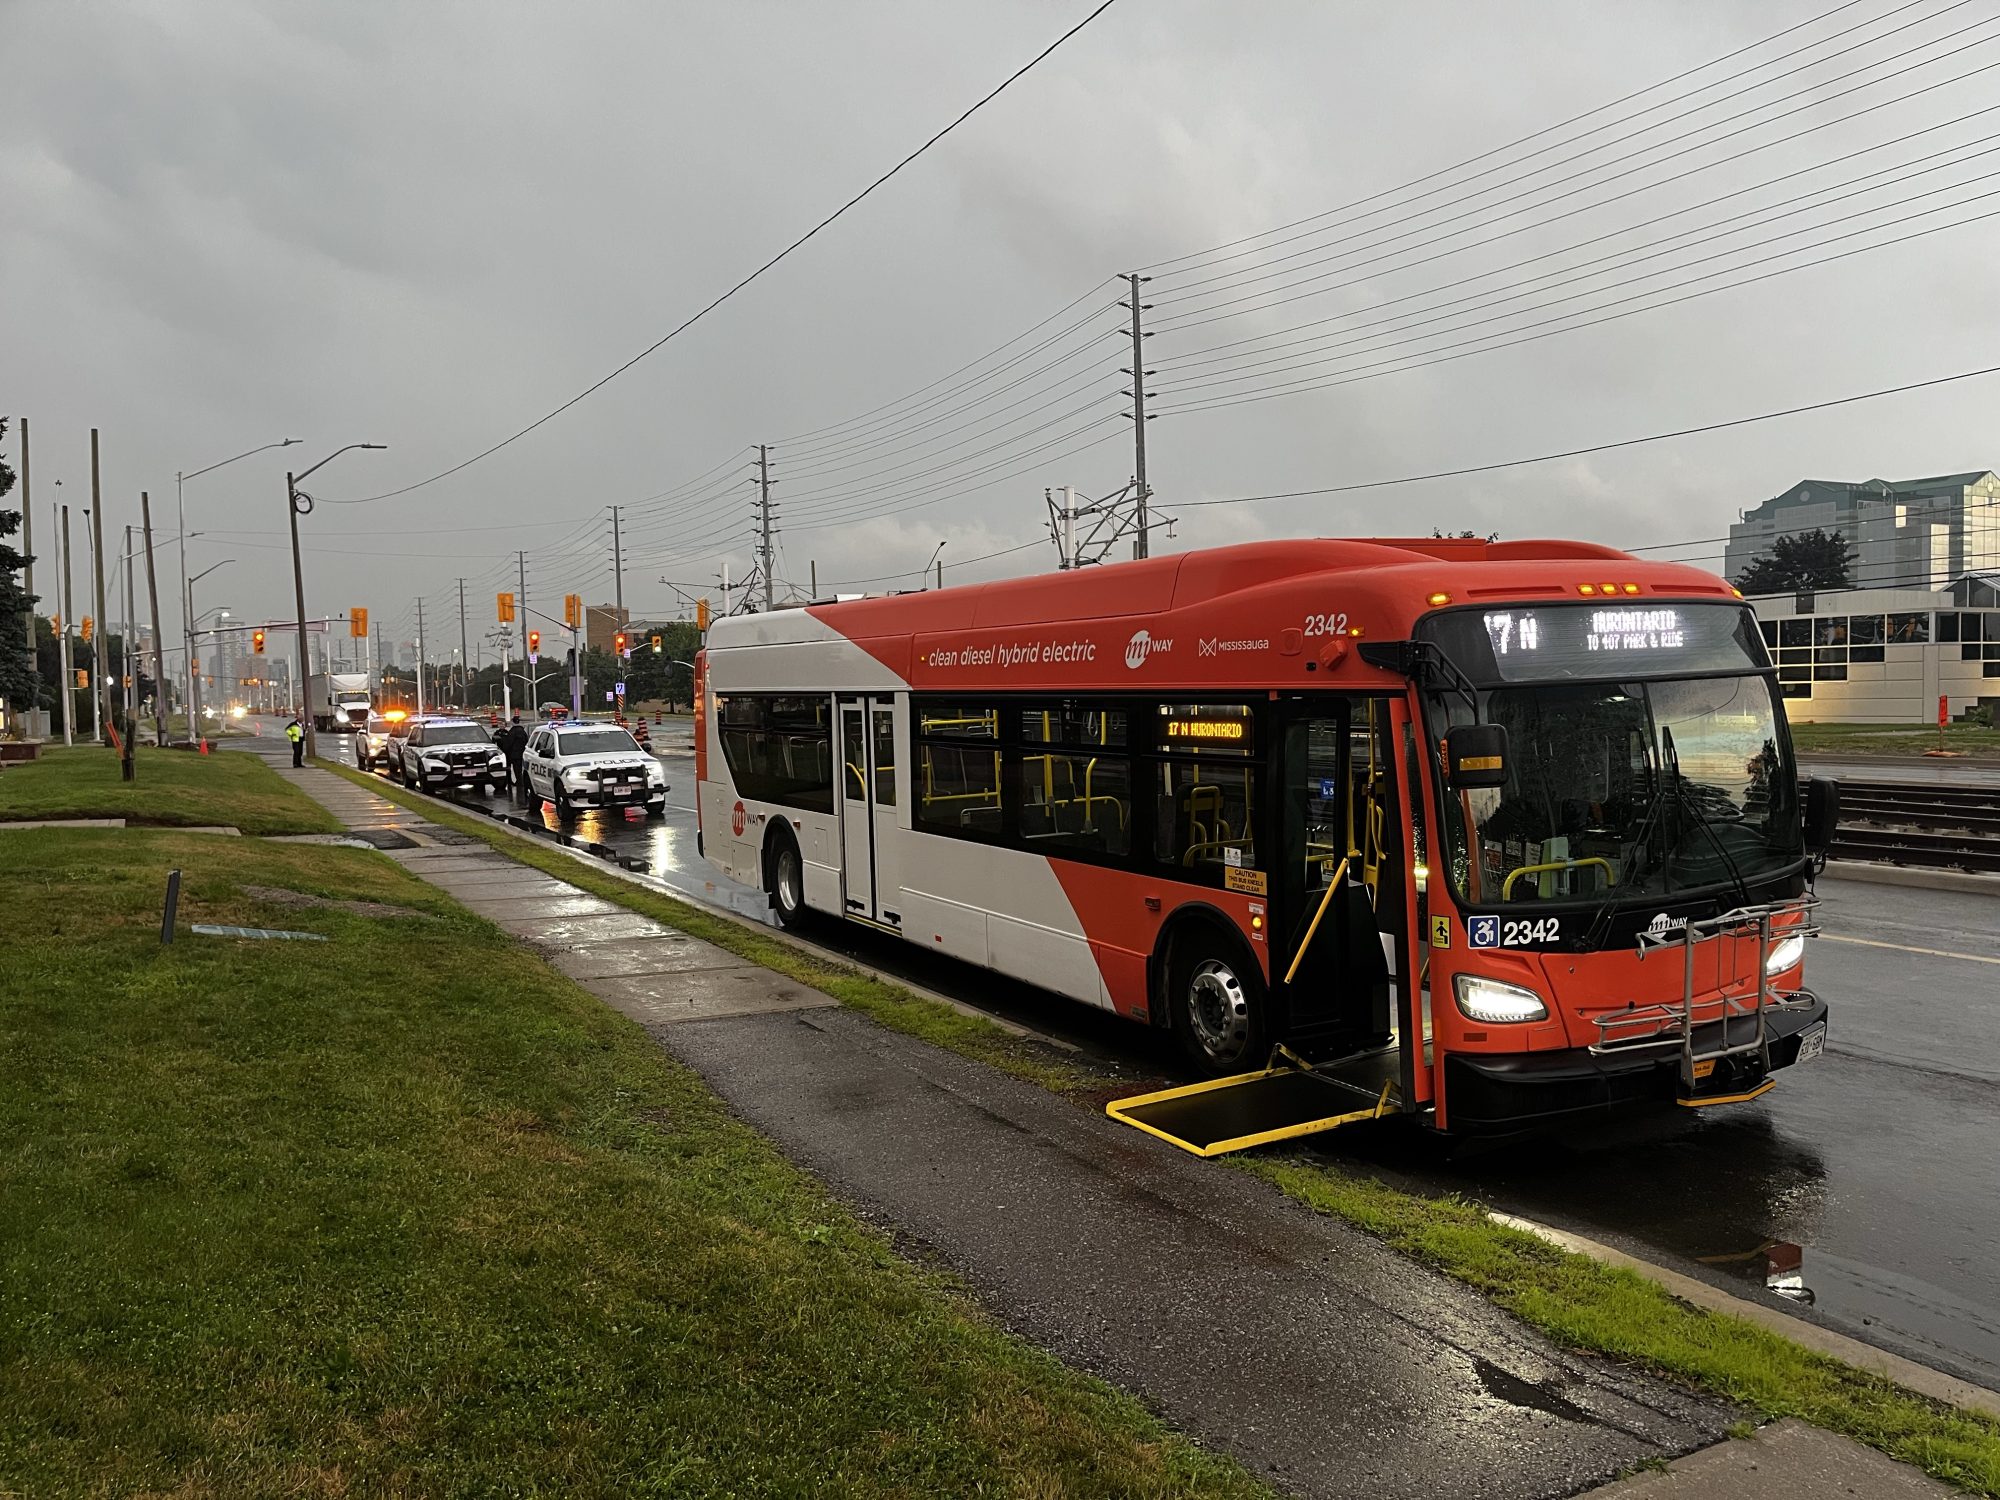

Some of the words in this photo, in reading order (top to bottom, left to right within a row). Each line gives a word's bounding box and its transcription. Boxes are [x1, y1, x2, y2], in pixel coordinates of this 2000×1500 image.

[1304, 613, 1348, 636] 2342
[1520, 618, 1537, 650] N
[929, 648, 957, 667] clean
[960, 644, 996, 666] diesel
[997, 642, 1040, 668] hybrid
[1042, 639, 1096, 663] electric
[1168, 722, 1179, 736] 17
[1181, 722, 1188, 736] N
[1190, 722, 1242, 738] HURONTARIO
[593, 758, 640, 766] POLICE
[1234, 869, 1257, 879] CAUTION
[1503, 917, 1560, 946] 2342
